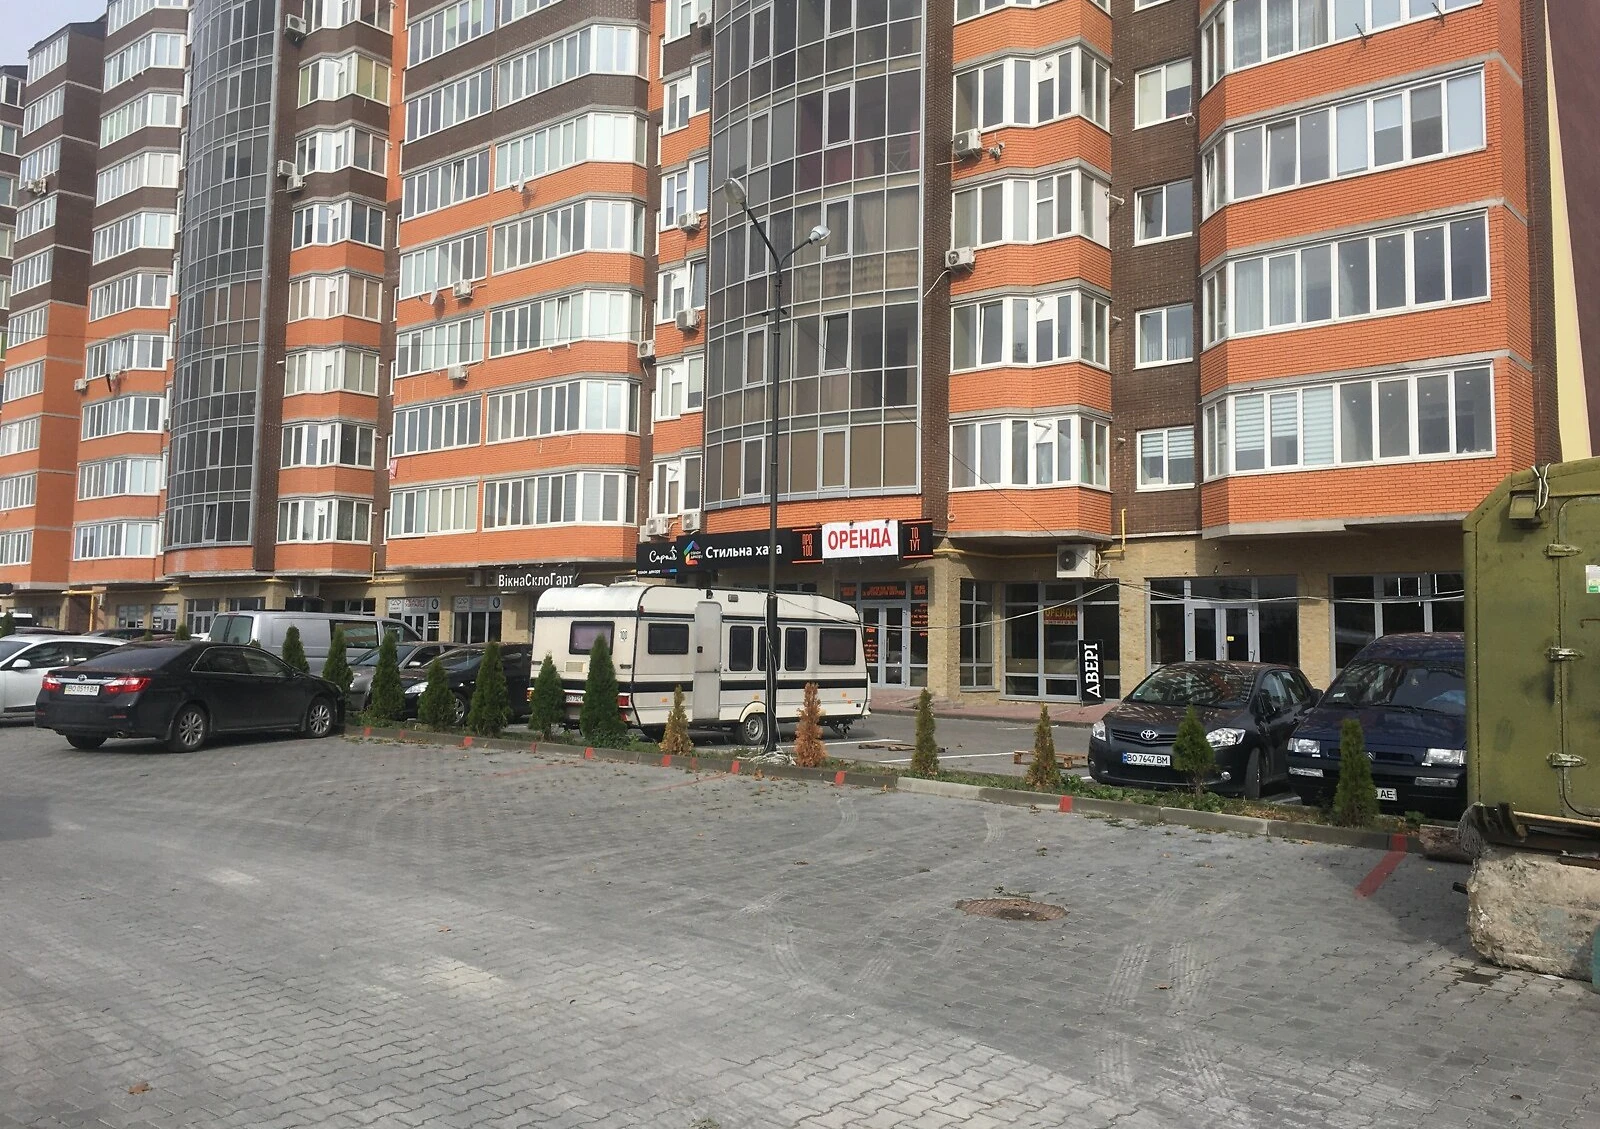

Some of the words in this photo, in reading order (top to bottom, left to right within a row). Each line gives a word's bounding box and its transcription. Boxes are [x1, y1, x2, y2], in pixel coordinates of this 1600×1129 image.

[828, 528, 892, 550] ОРЕНДА
[910, 527, 919, 540] ТО
[705, 546, 753, 559] Стильна
[755, 544, 783, 556] хаа
[802, 545, 813, 556] 100
[909, 539, 921, 552] ТУТ
[498, 572, 574, 588] ВікнаСклоГарт
[1084, 643, 1102, 698] ДВЕРІ
[1127, 753, 1138, 763] BO
[1138, 754, 1156, 764] 7647
[1156, 755, 1168, 764] BM
[1380, 789, 1394, 799] AE
